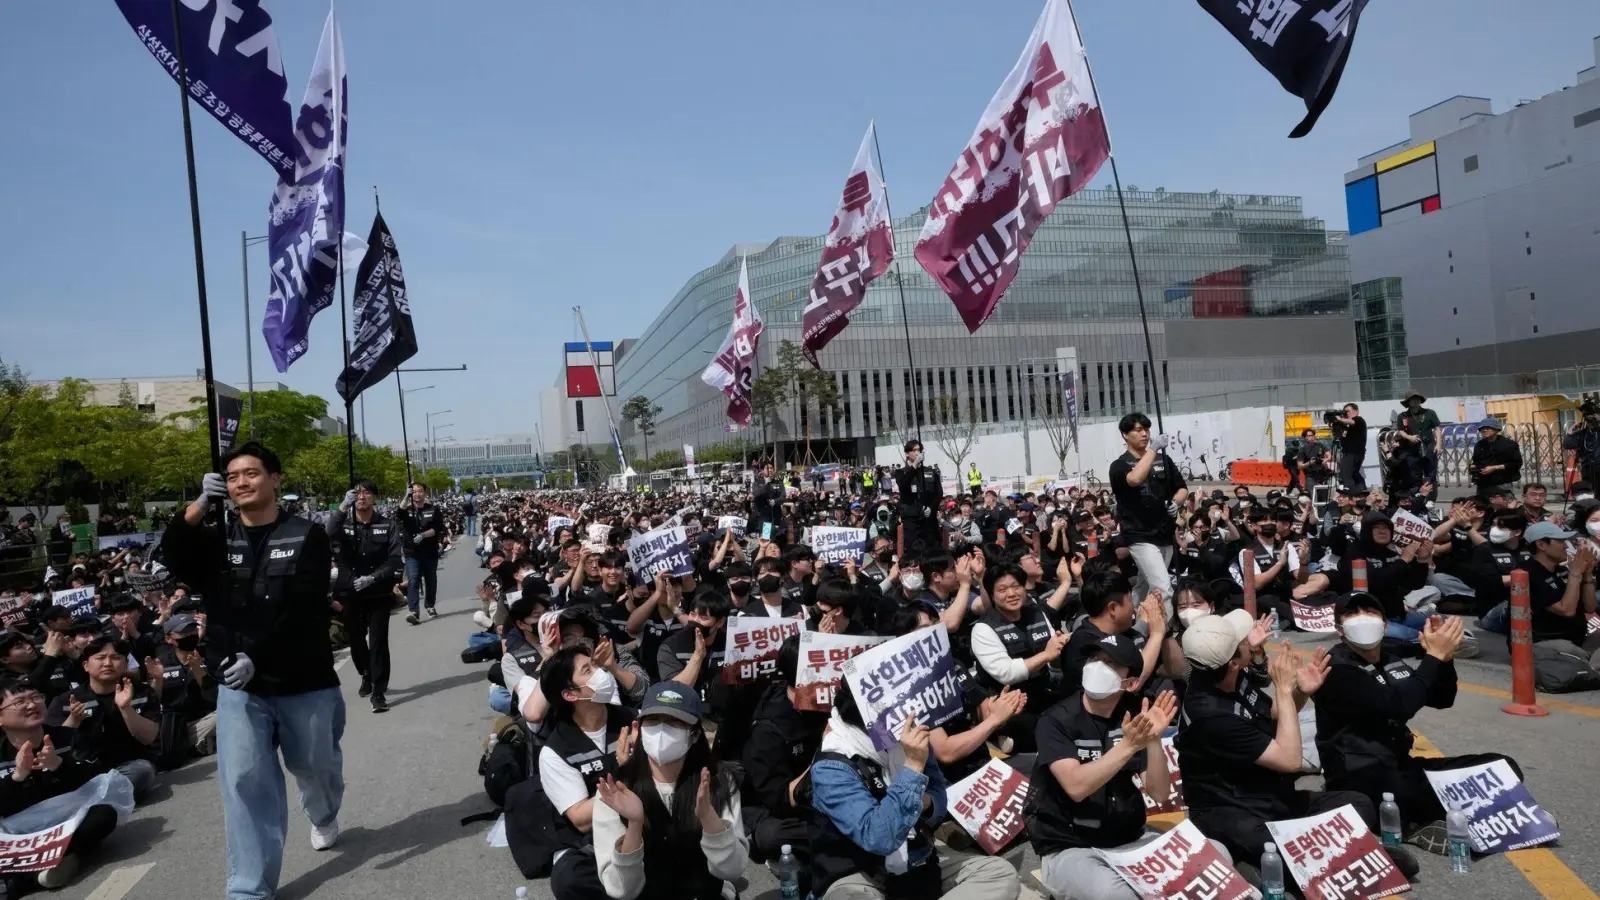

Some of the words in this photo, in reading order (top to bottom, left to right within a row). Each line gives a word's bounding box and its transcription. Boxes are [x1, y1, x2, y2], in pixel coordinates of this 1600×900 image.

[228, 113, 295, 170] 공동투쟁본부
[815, 531, 859, 547] 상한폐지
[1395, 516, 1433, 538] 투명하게
[227, 553, 243, 564] 쟁
[270, 549, 294, 559] SELU
[630, 530, 677, 565] 상한폐지
[733, 621, 800, 652] 투명하게
[859, 629, 943, 704] 상한폐지
[885, 670, 957, 741] 실현하자
[580, 759, 604, 775] 투쟁
[1077, 748, 1101, 760] 투쟁
[954, 766, 1003, 820] 투명하게
[1284, 812, 1356, 868] 투명하게
[1114, 830, 1193, 886] 투명하게
[1317, 849, 1394, 900] 바꾸고!!!
